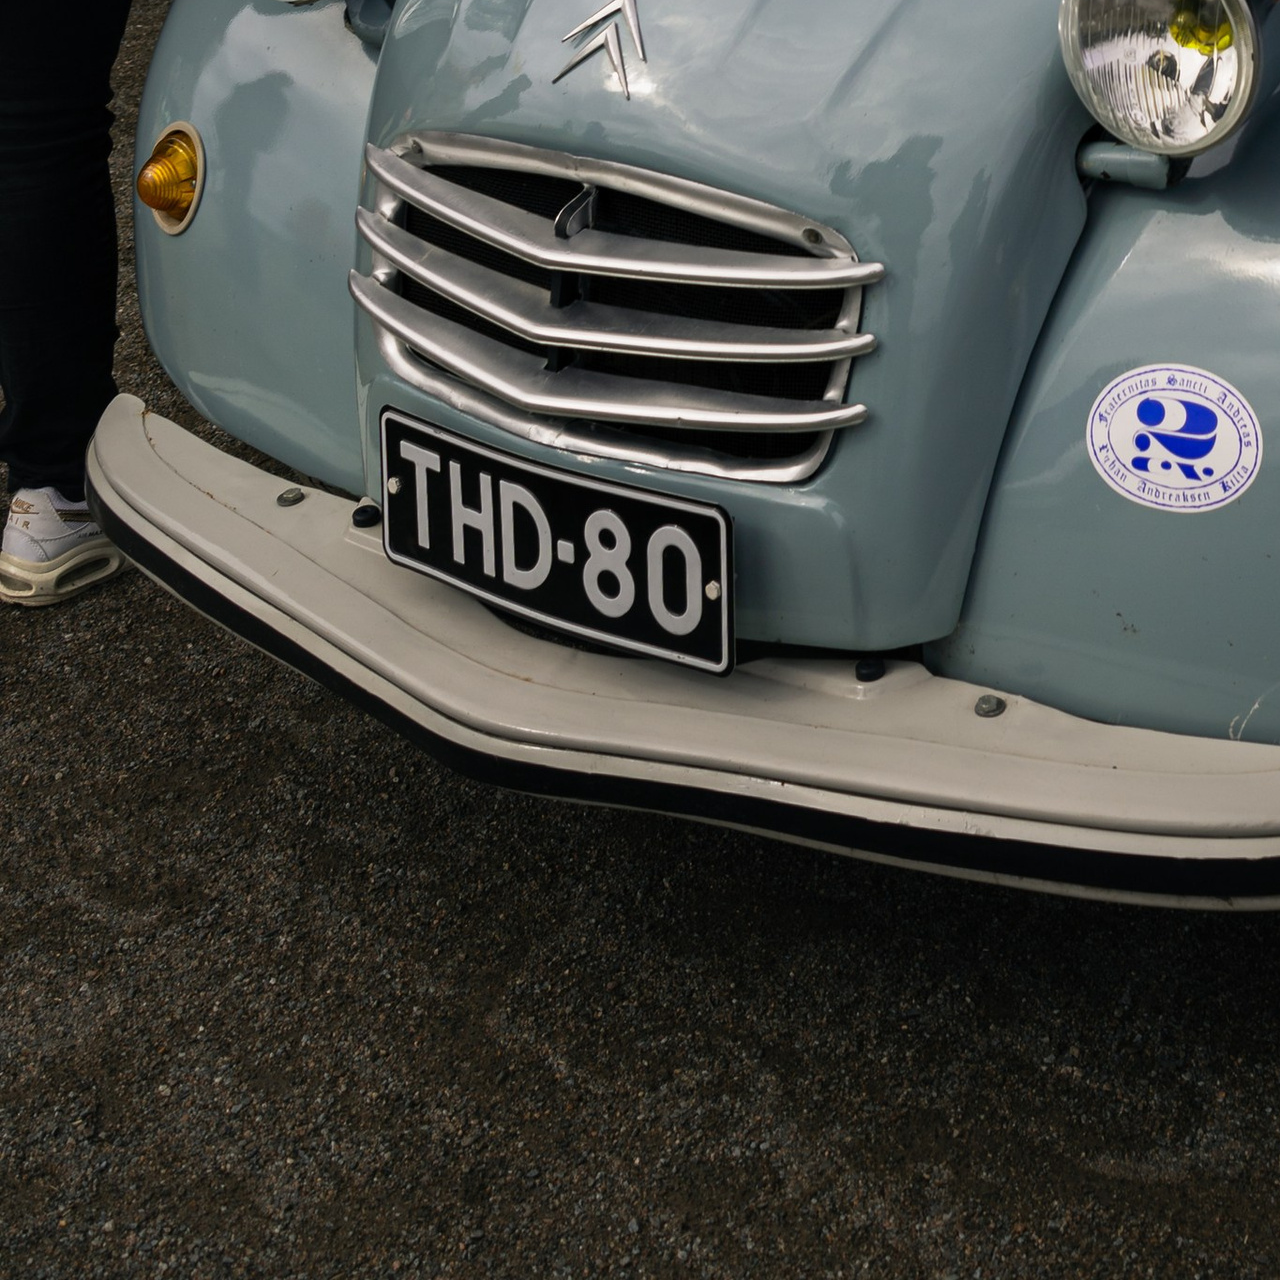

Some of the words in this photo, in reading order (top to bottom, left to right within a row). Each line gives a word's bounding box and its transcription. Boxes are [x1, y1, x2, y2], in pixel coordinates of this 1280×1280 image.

[1166, 374, 1208, 394] Sancti
[1217, 391, 1252, 448] Andreas
[9, 514, 30, 530] AIR
[400, 440, 703, 636] THD-80
